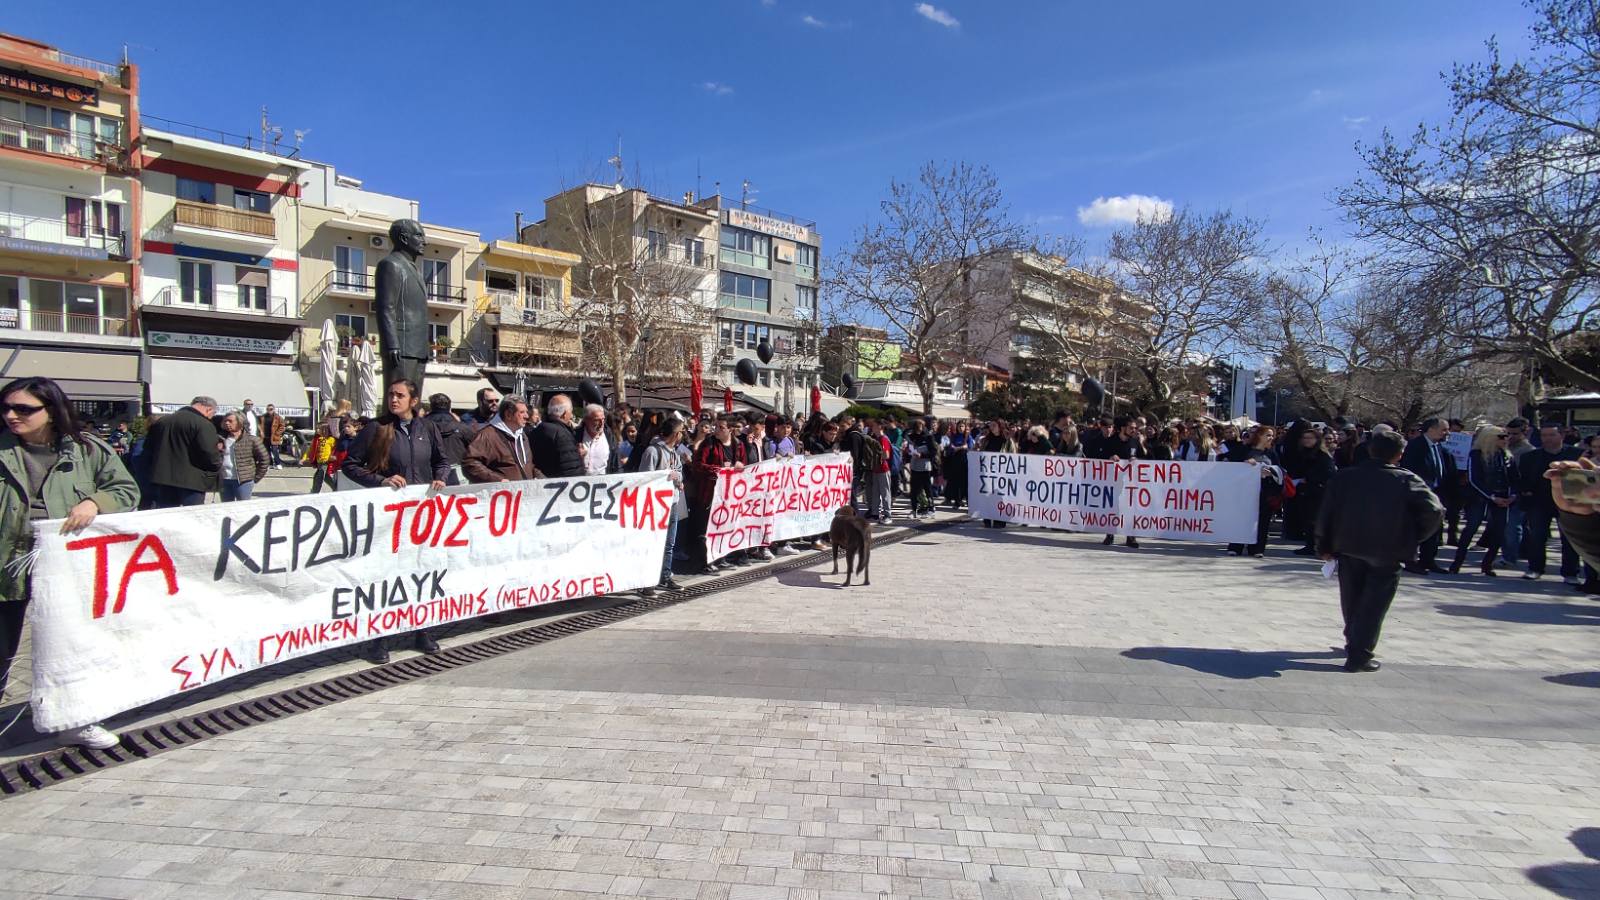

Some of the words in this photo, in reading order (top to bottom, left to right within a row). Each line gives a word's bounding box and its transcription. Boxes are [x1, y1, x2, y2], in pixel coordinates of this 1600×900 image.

[719, 467, 747, 501] ΤΟ
[810, 464, 851, 486] ΟΤΑΝ
[980, 455, 1027, 475] ΚΕΡΔΗ
[1044, 458, 1182, 483] ΒΟΥΤΗΓΜΕΝΑ
[980, 475, 1018, 497] ΣΤΩΝ
[1025, 480, 1114, 509] ΦΟΙΤΗΤΩΝ
[1125, 486, 1151, 507] ΤΟ
[1164, 488, 1214, 511] ΑΙΜΑ
[997, 500, 1061, 524] ΦΟΙΤΗΤΙΚΟΙ
[1133, 515, 1214, 534] ΚΟΜΟΤΗΝΗΣ
[707, 523, 773, 556] ΠΟΤΕ
[66, 533, 179, 619] ΤΑ
[213, 502, 374, 581] ΚΕΡΔΗ
[332, 569, 447, 619] ΕΝΙΔΥΚ
[171, 647, 242, 691] ΣΥΛ.
[258, 616, 358, 665] ΓΥΝΑΙΚΩΝ
[367, 588, 488, 637] ΚΟΜΟΤΗΝΗΣ
